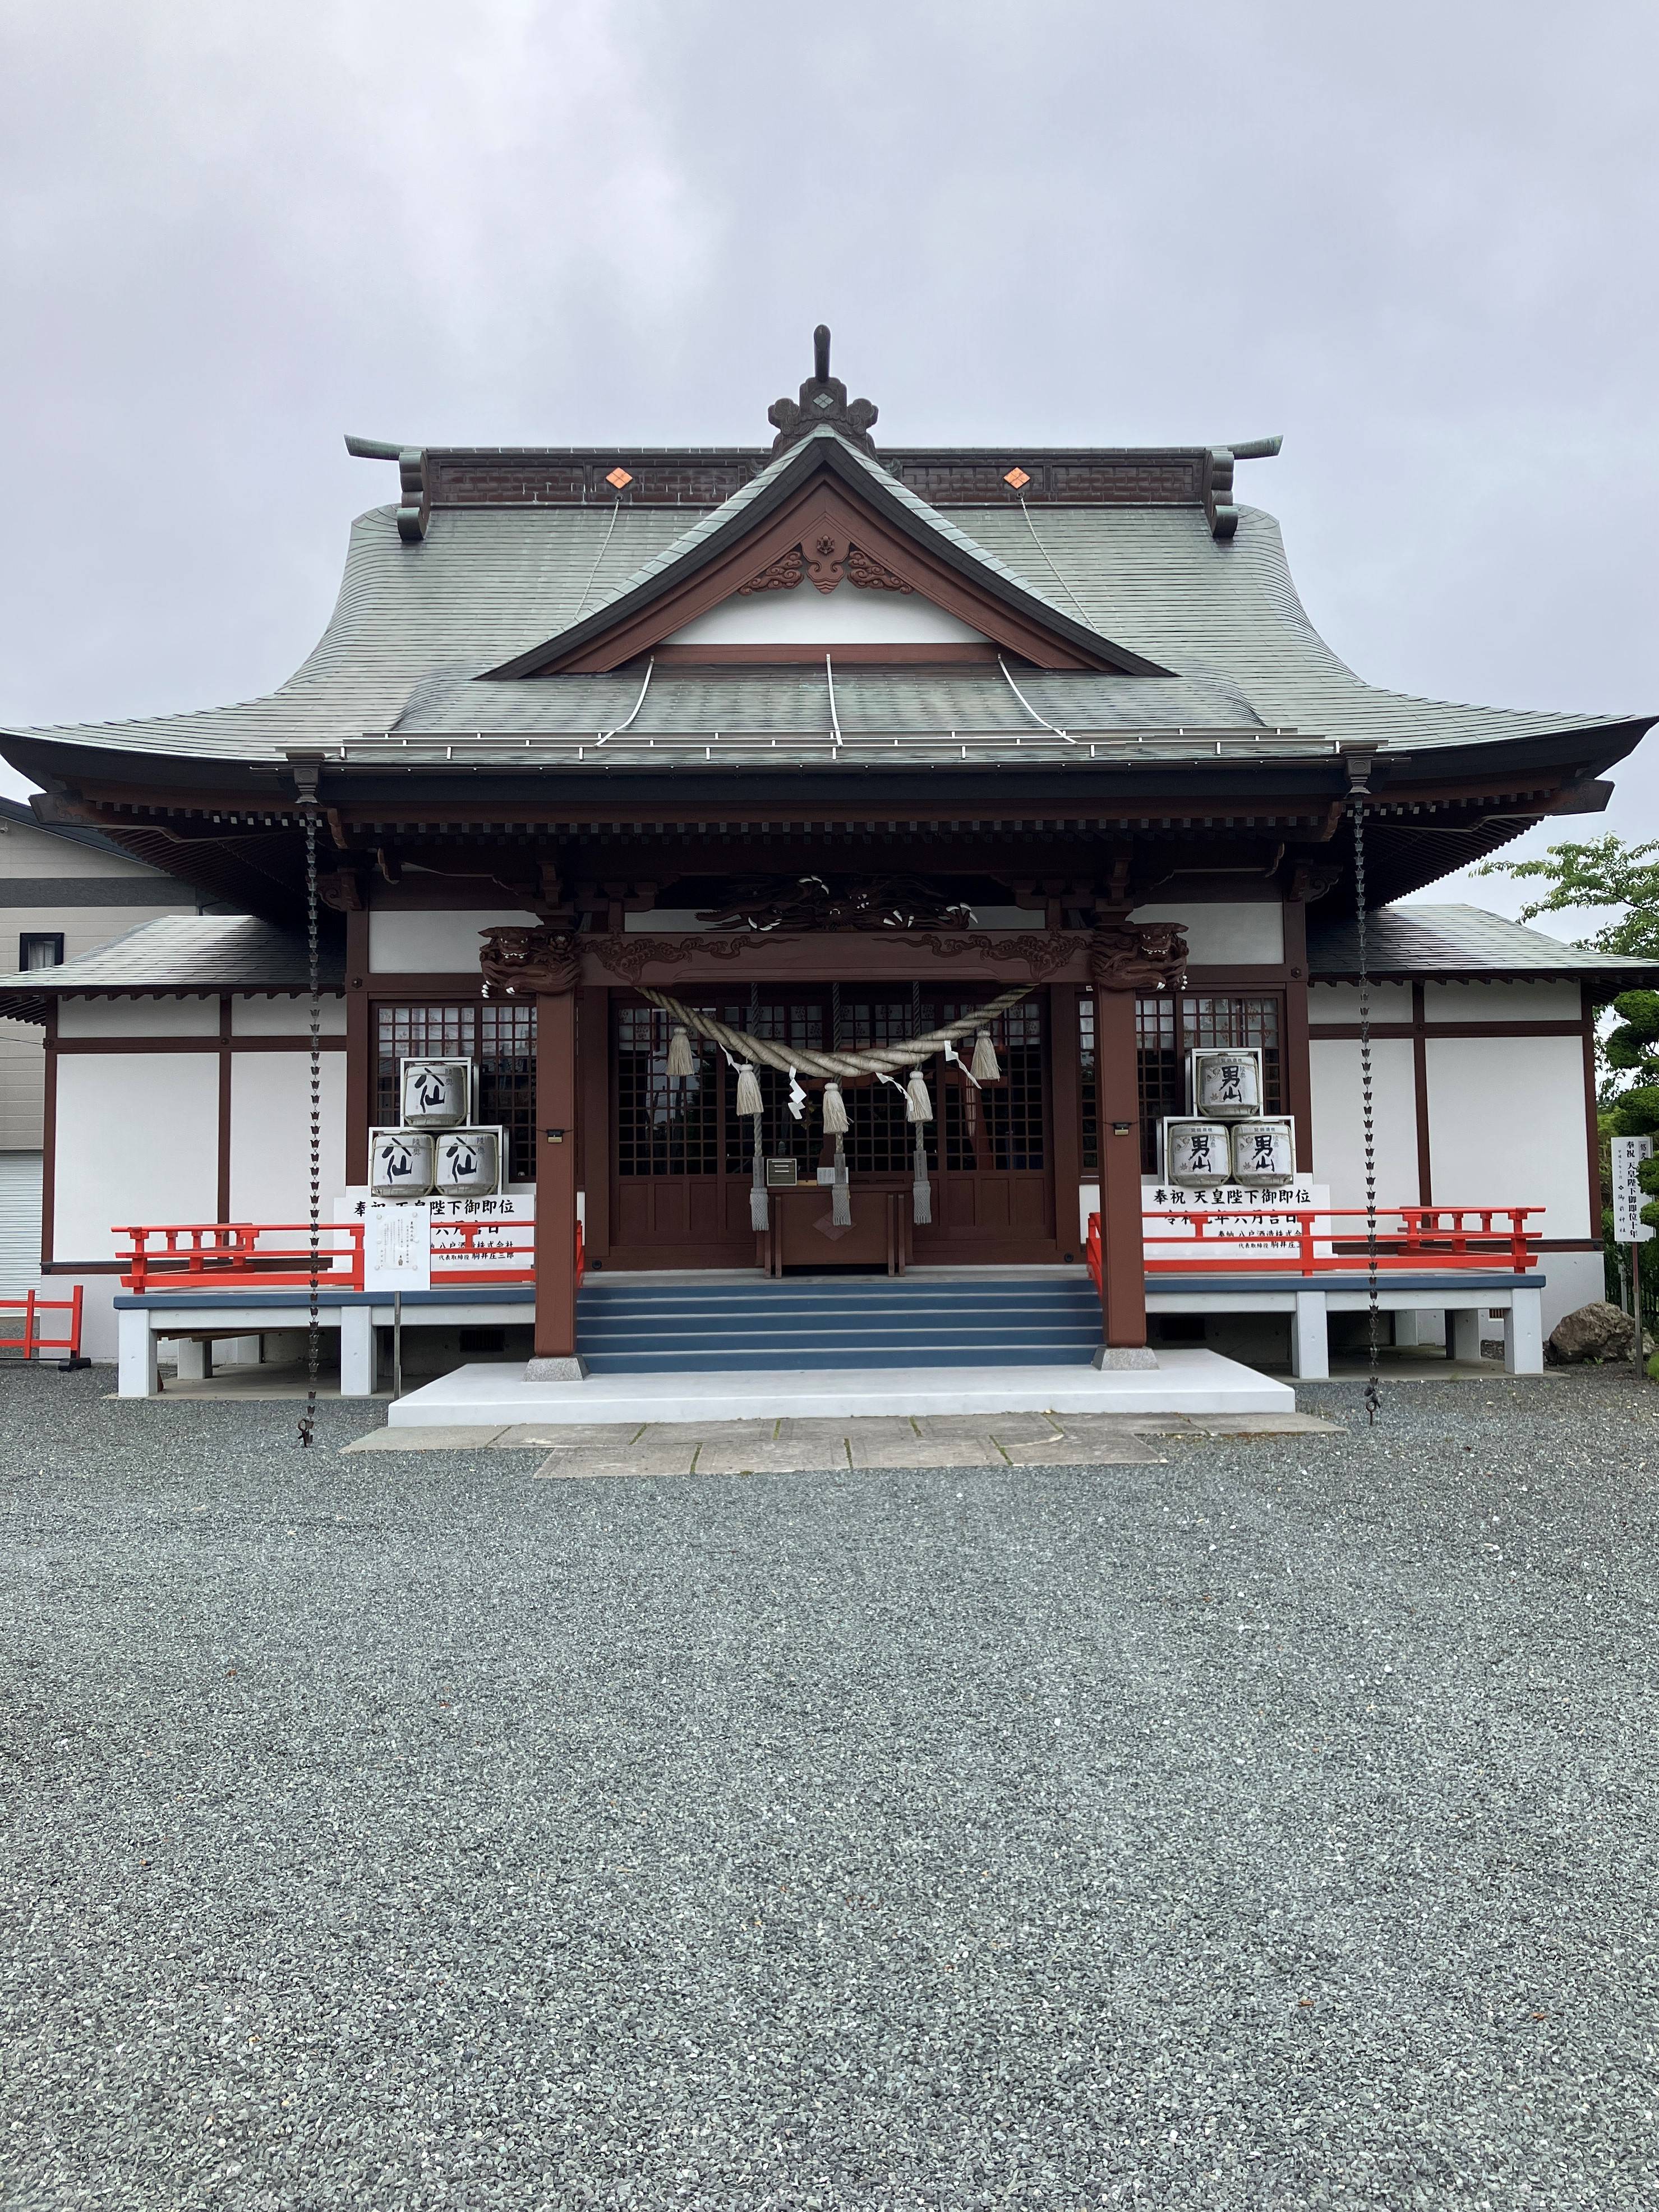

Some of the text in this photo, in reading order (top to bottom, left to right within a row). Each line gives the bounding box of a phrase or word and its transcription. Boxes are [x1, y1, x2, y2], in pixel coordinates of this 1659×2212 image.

[414, 1067, 446, 1114] 八仙
[1218, 1065, 1242, 1103] 男山
[381, 1137, 413, 1184] 八仙
[446, 1136, 478, 1183] 八仙
[1188, 1135, 1212, 1173] 男山
[1251, 1134, 1275, 1172] 男山
[1153, 1188, 1311, 1205] 奉祝 天皇陛下御即位
